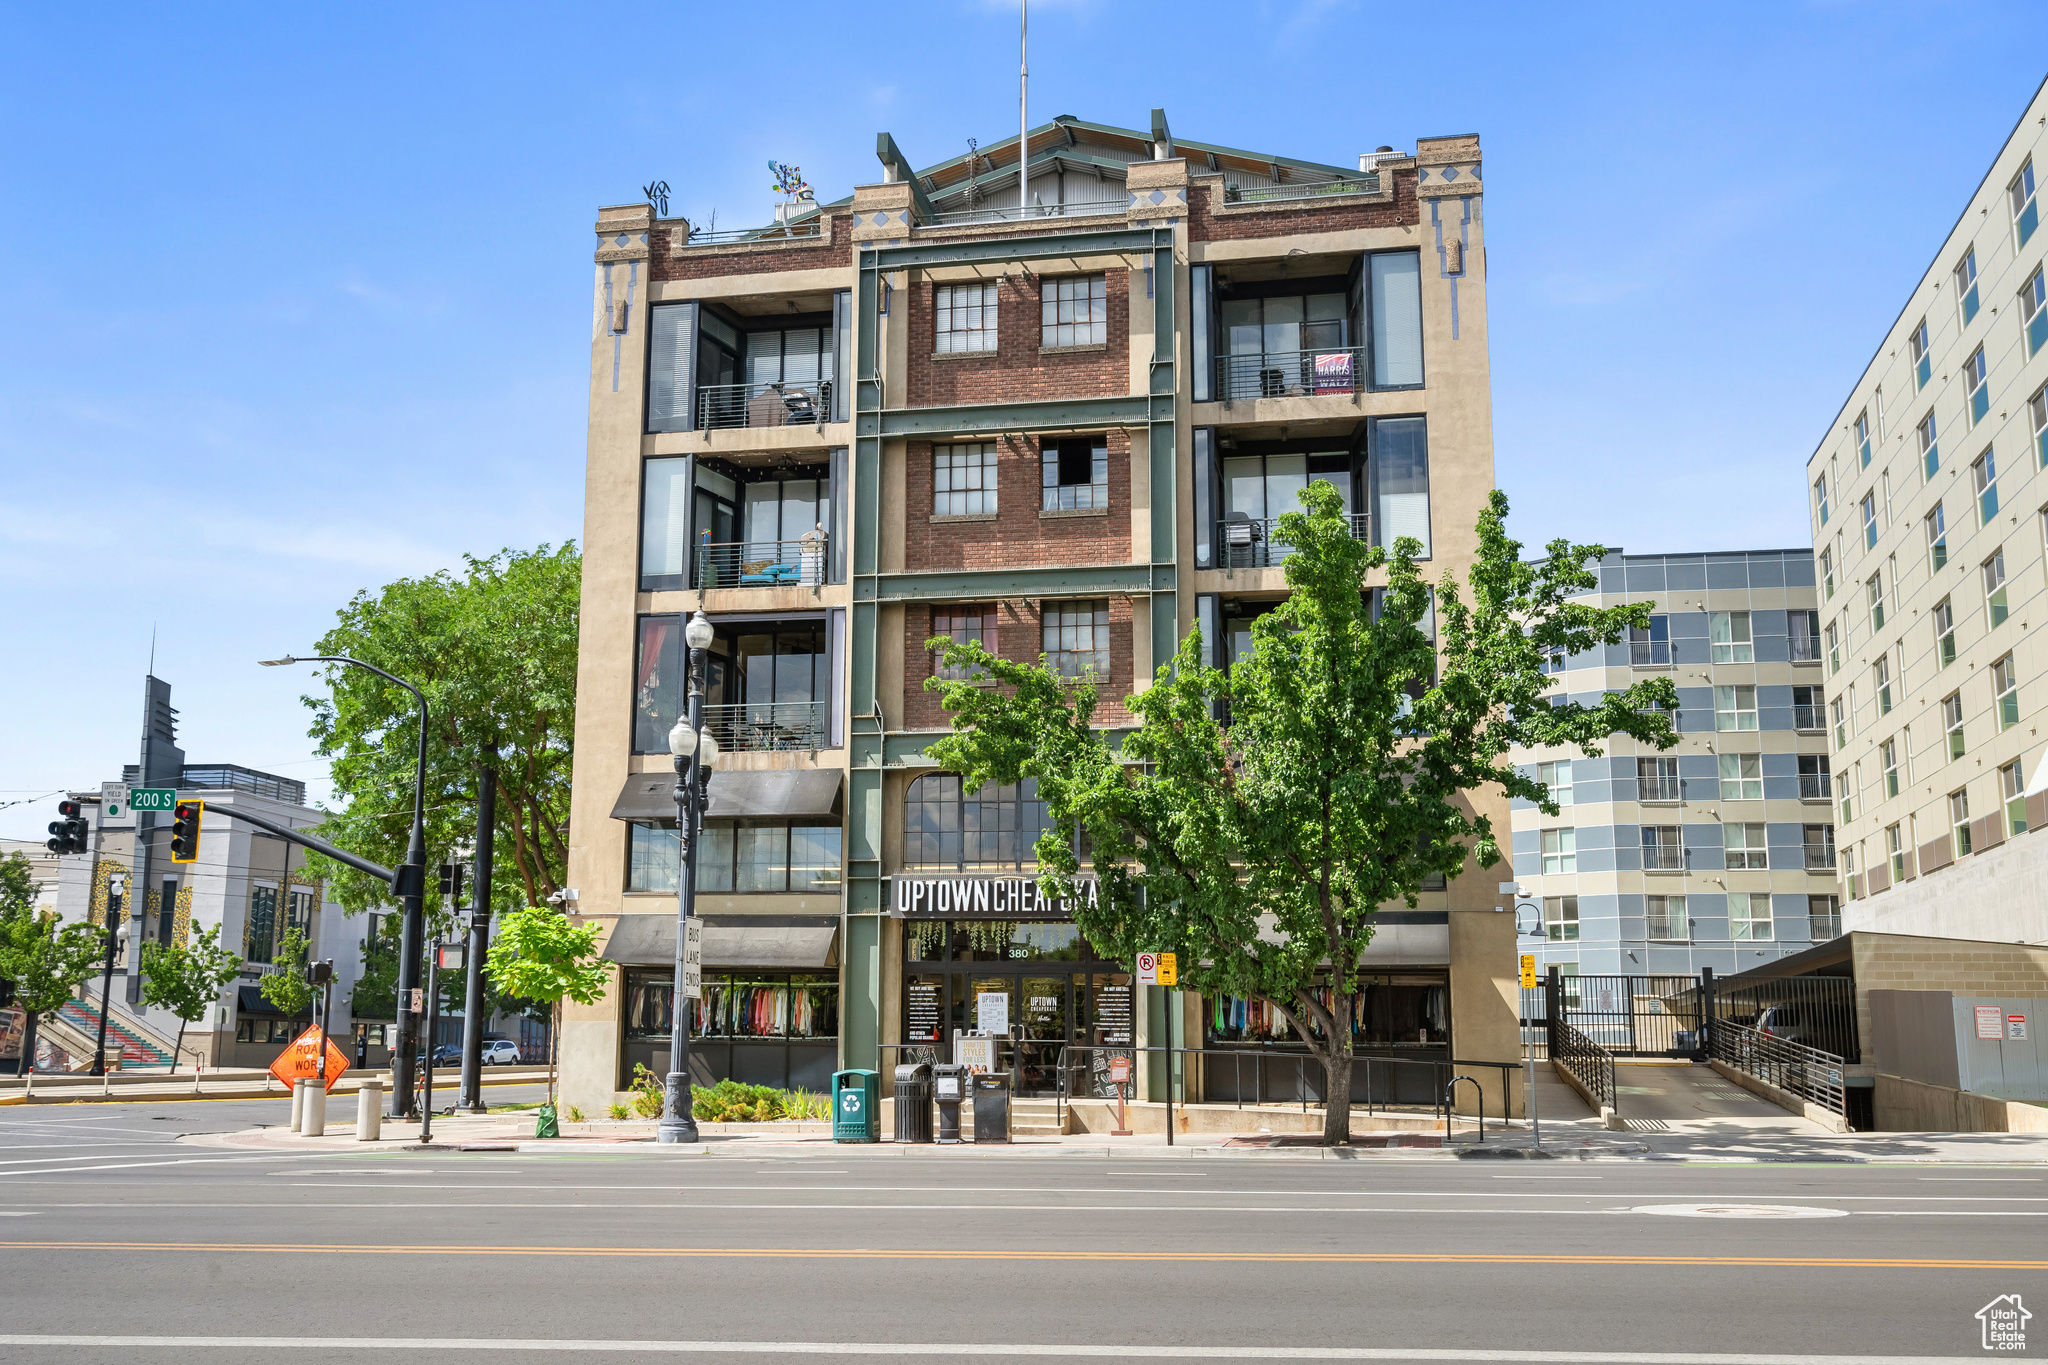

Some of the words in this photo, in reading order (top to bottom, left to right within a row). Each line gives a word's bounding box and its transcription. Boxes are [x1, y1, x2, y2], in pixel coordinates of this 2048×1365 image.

[1318, 365, 1350, 375] HARRIS
[1319, 378, 1349, 387] WALZ
[135, 793, 159, 806] 200
[163, 793, 171, 806] S
[899, 880, 989, 911] UPTOWN
[689, 927, 699, 942] BUS
[686, 950, 699, 965] LANE
[1008, 949, 1029, 958] 380
[686, 972, 699, 987] ENDS
[982, 995, 1004, 1003] UPTOWN
[1030, 996, 1057, 1006] UPTOWN
[296, 1045, 321, 1055] ROA
[295, 1060, 318, 1070] WOR
